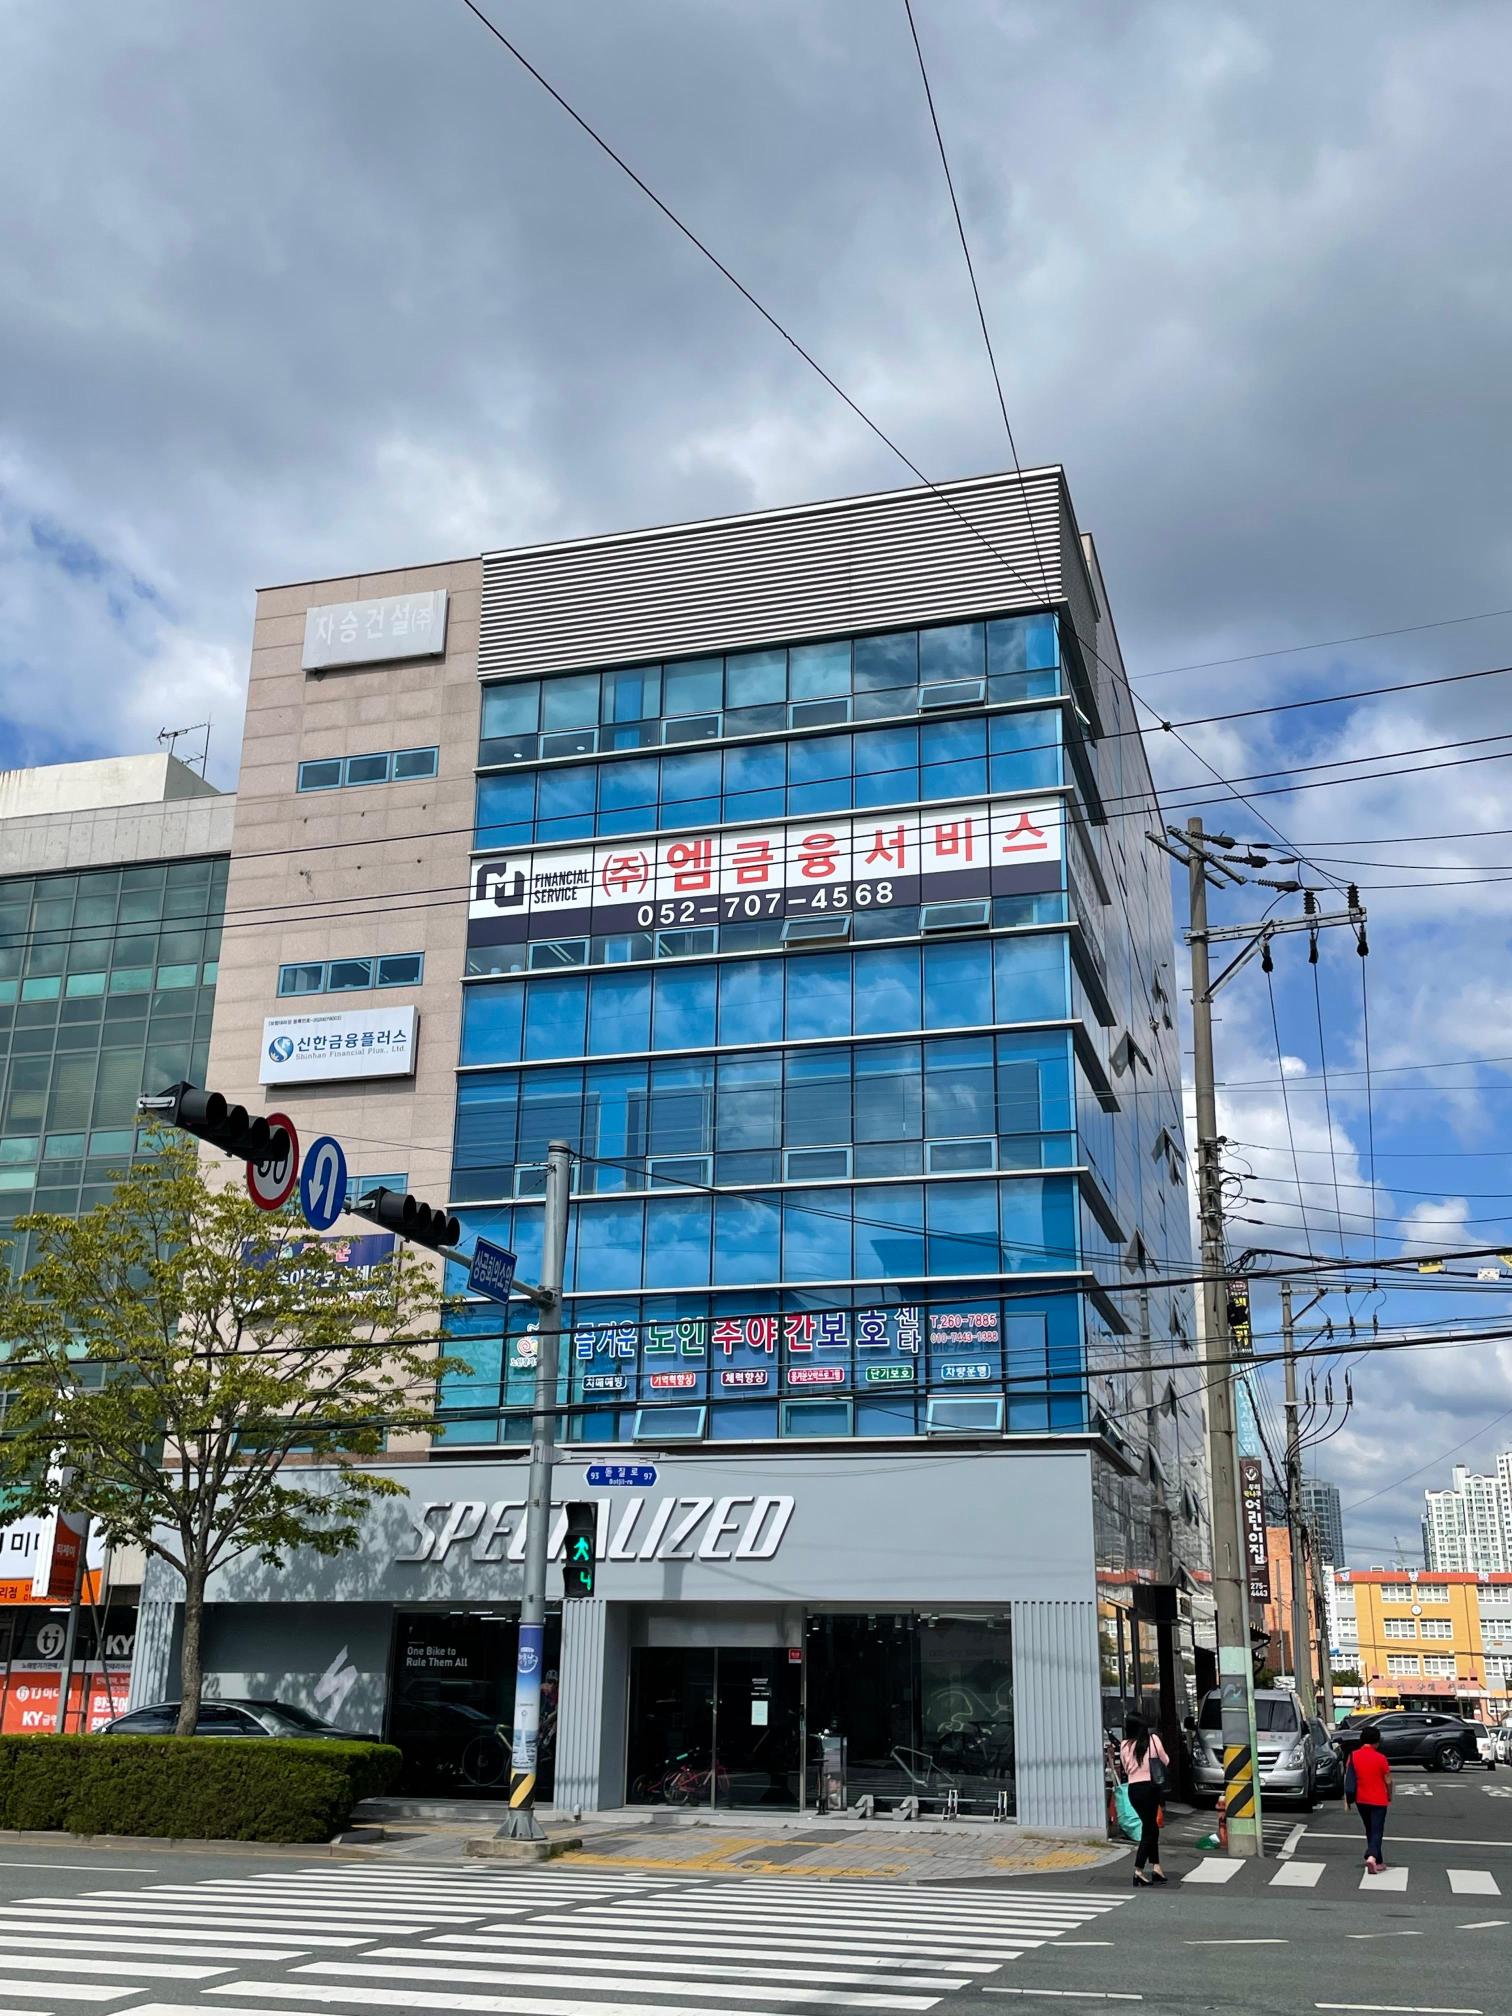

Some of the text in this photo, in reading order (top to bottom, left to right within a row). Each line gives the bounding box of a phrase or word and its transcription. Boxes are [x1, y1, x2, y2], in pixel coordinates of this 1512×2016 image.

[534, 869, 590, 888] FINANCIAL
[533, 886, 578, 904] SERVICE
[637, 881, 893, 927] 052-707-4568
[297, 1029, 407, 1052] 신한금융플러스
[295, 1052, 327, 1061] Shinhan
[329, 1049, 365, 1058] Financial
[590, 1472, 600, 1480] 93
[643, 1472, 653, 1480] 97
[1245, 1499, 1266, 1565] 어린이집
[407, 1646, 457, 1656] One Bike to
[406, 1657, 468, 1667] Rule Them All
